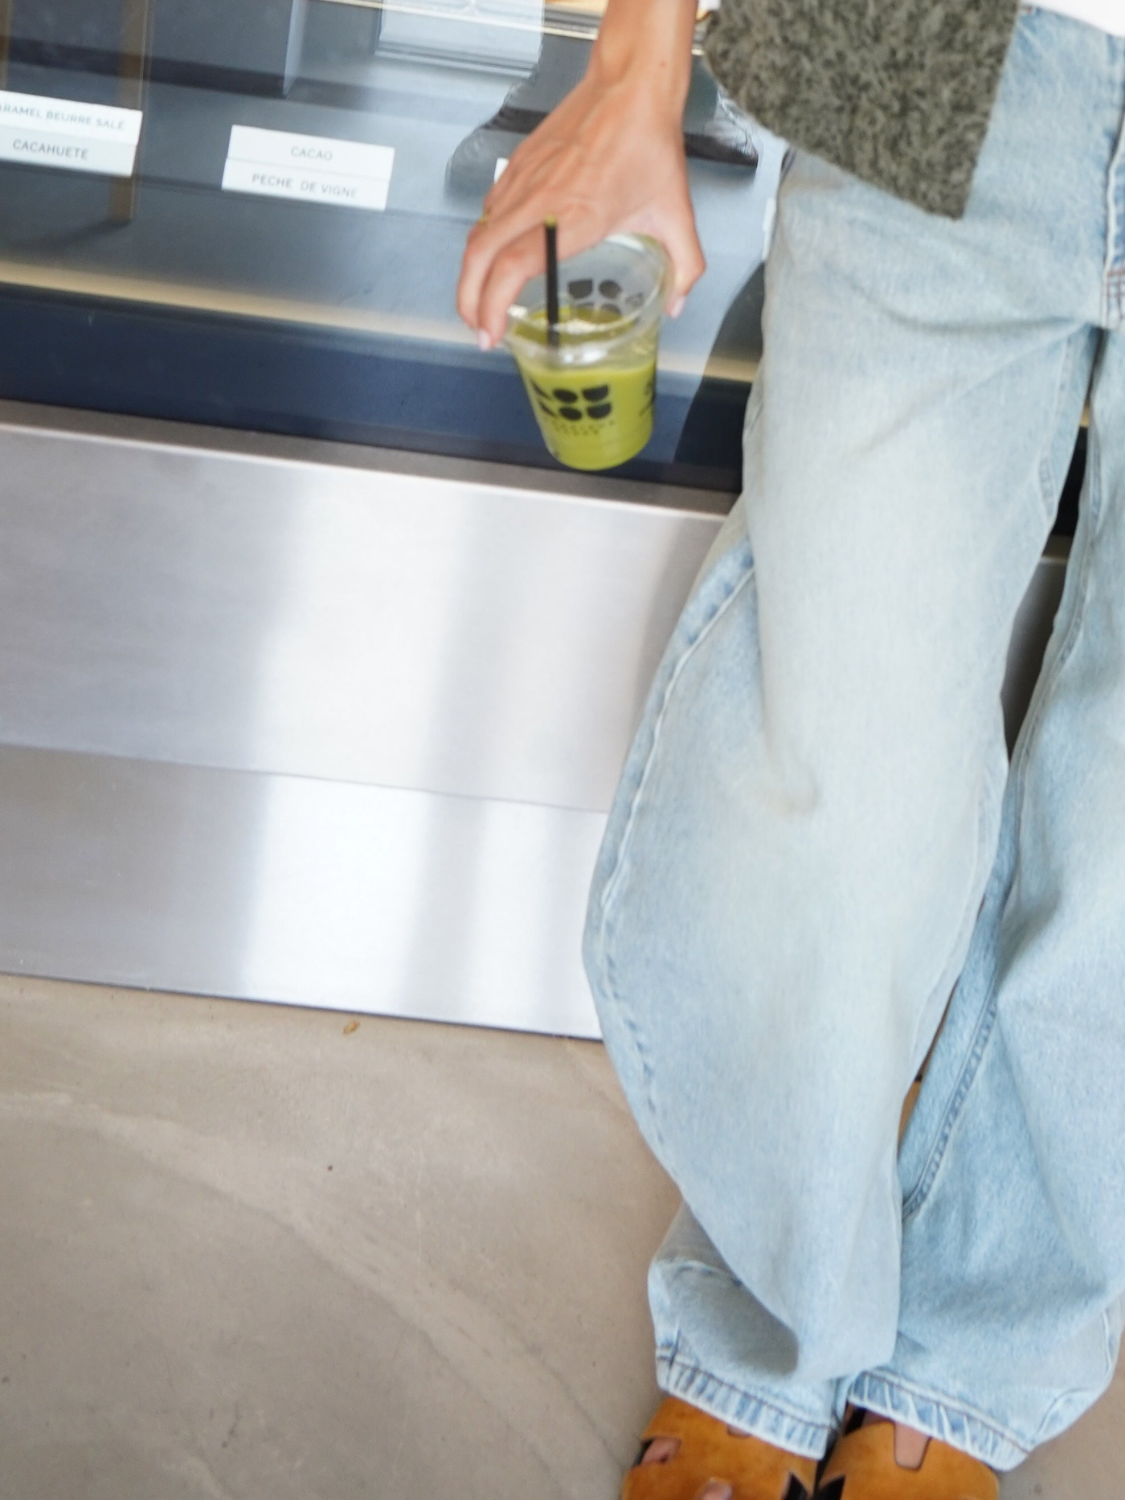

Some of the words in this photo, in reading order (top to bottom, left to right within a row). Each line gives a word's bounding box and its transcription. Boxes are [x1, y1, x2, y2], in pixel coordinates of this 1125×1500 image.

[46, 110, 92, 125] BEURRE
[12, 138, 89, 160] CACAHUETE
[290, 145, 333, 161] CACAO
[300, 180, 318, 192] DE
[321, 183, 359, 198] VIGNE
